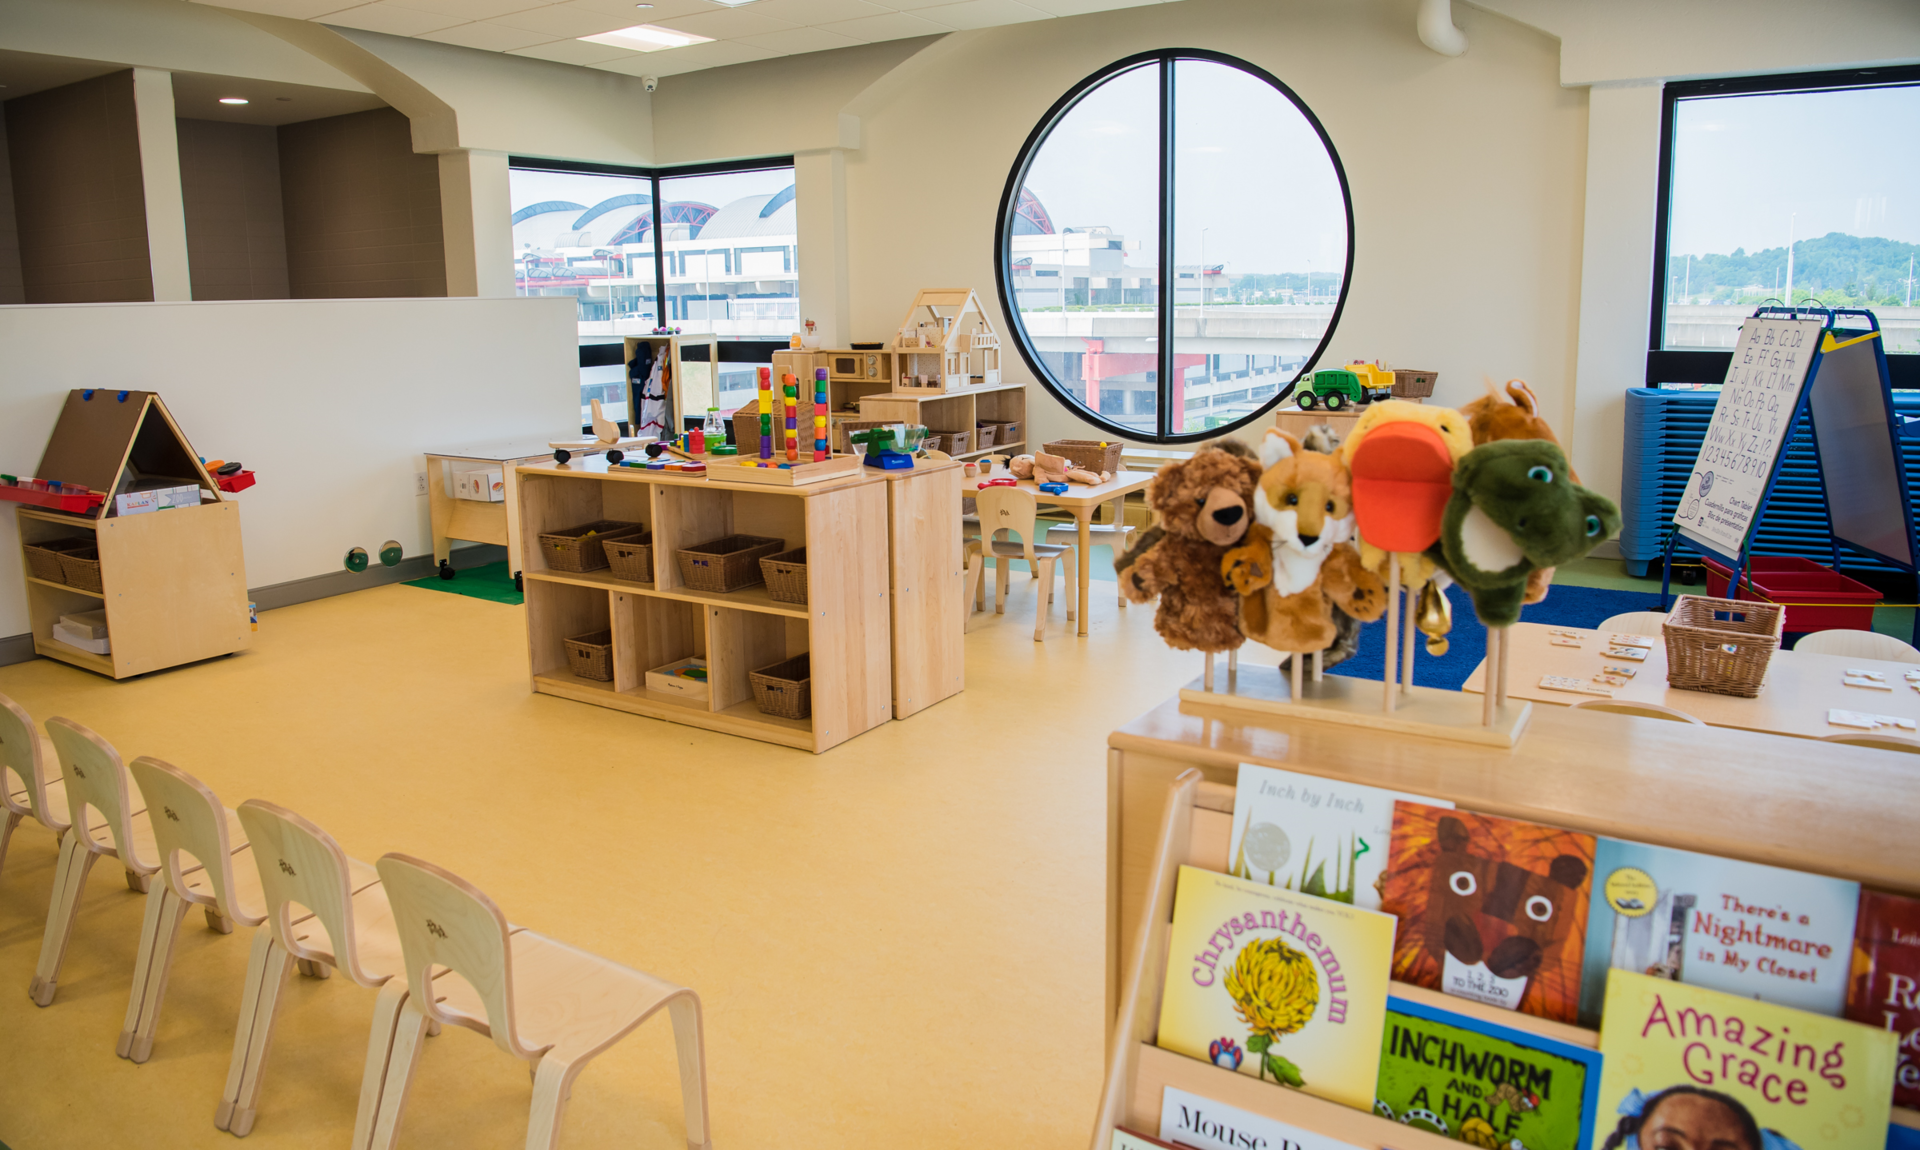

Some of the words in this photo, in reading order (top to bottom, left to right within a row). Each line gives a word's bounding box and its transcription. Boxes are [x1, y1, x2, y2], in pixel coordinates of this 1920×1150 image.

[1707, 510, 1715, 519] Bloc
[1714, 514, 1721, 522] de
[1723, 508, 1733, 516] para
[1729, 496, 1740, 507] Chart
[1741, 500, 1752, 512] Tablet
[1259, 779, 1296, 800] Inch
[1301, 788, 1322, 808] by
[1325, 792, 1365, 814] Inch
[1721, 893, 1790, 922] There's
[1798, 915, 1810, 926] a
[1693, 910, 1832, 959] Nightmare
[1192, 910, 1348, 1024] Chrysanthemum
[1698, 947, 1715, 962] in
[1722, 949, 1750, 972] My
[1756, 956, 1818, 984] Closet
[1389, 1024, 1553, 1100] INCHWORM
[1641, 993, 1846, 1090] Amazing
[1446, 1078, 1483, 1099] AND
[1682, 1041, 1809, 1106] Grace
[1177, 1103, 1268, 1150] Mouse
[1408, 1086, 1431, 1111] A
[1442, 1093, 1522, 1136] HALF
